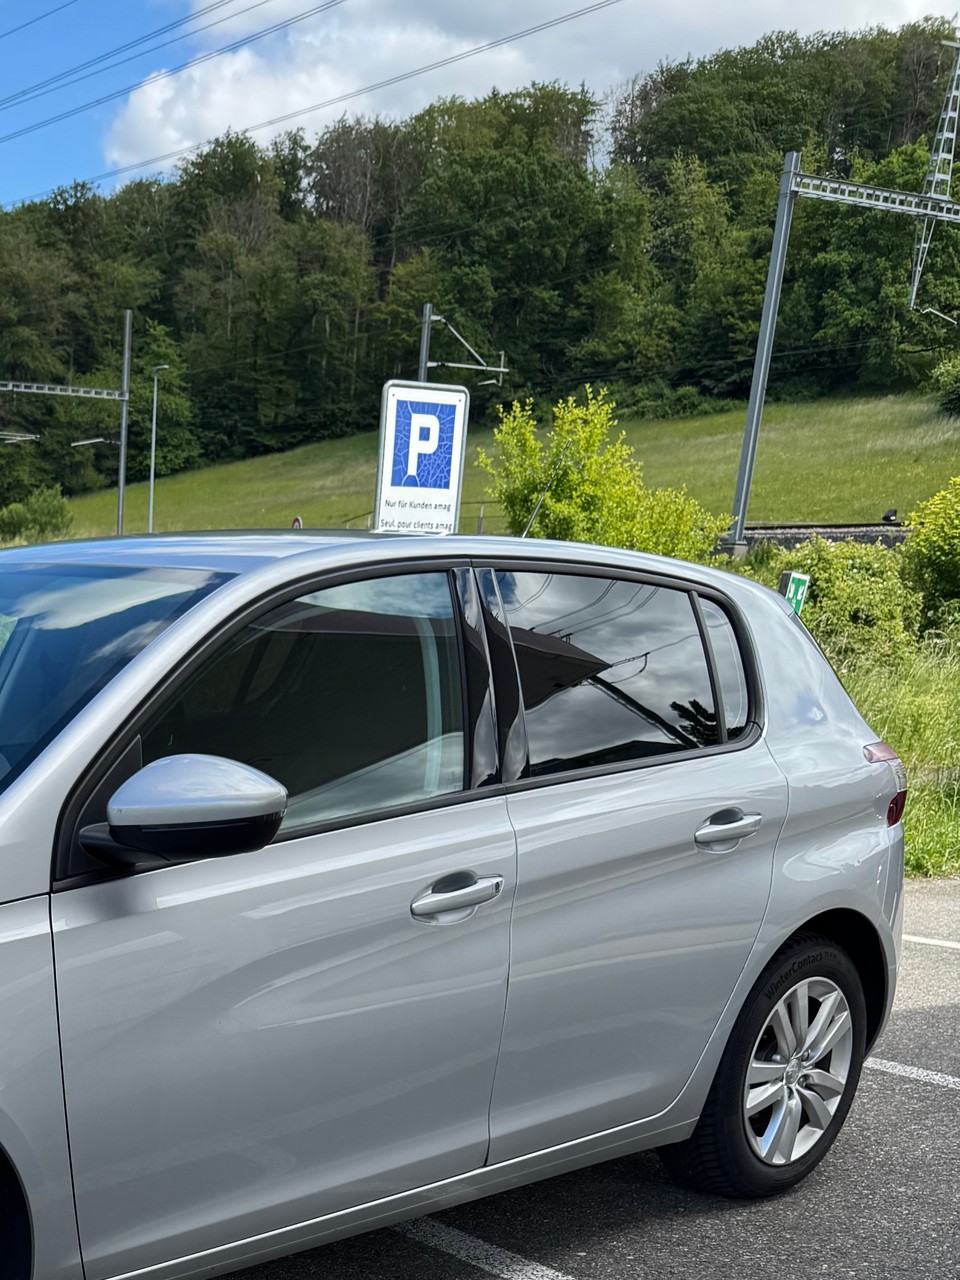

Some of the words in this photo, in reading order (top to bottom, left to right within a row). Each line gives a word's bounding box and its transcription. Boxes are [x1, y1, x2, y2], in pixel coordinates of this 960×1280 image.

[407, 413, 440, 476] P
[385, 500, 397, 508] Nur
[398, 500, 408, 509] für
[409, 501, 433, 510] Kunden
[434, 503, 451, 513] amag
[397, 521, 412, 529] pour
[413, 520, 434, 530] clients
[435, 523, 453, 532] amag
[765, 952, 823, 1001] WinterContact
